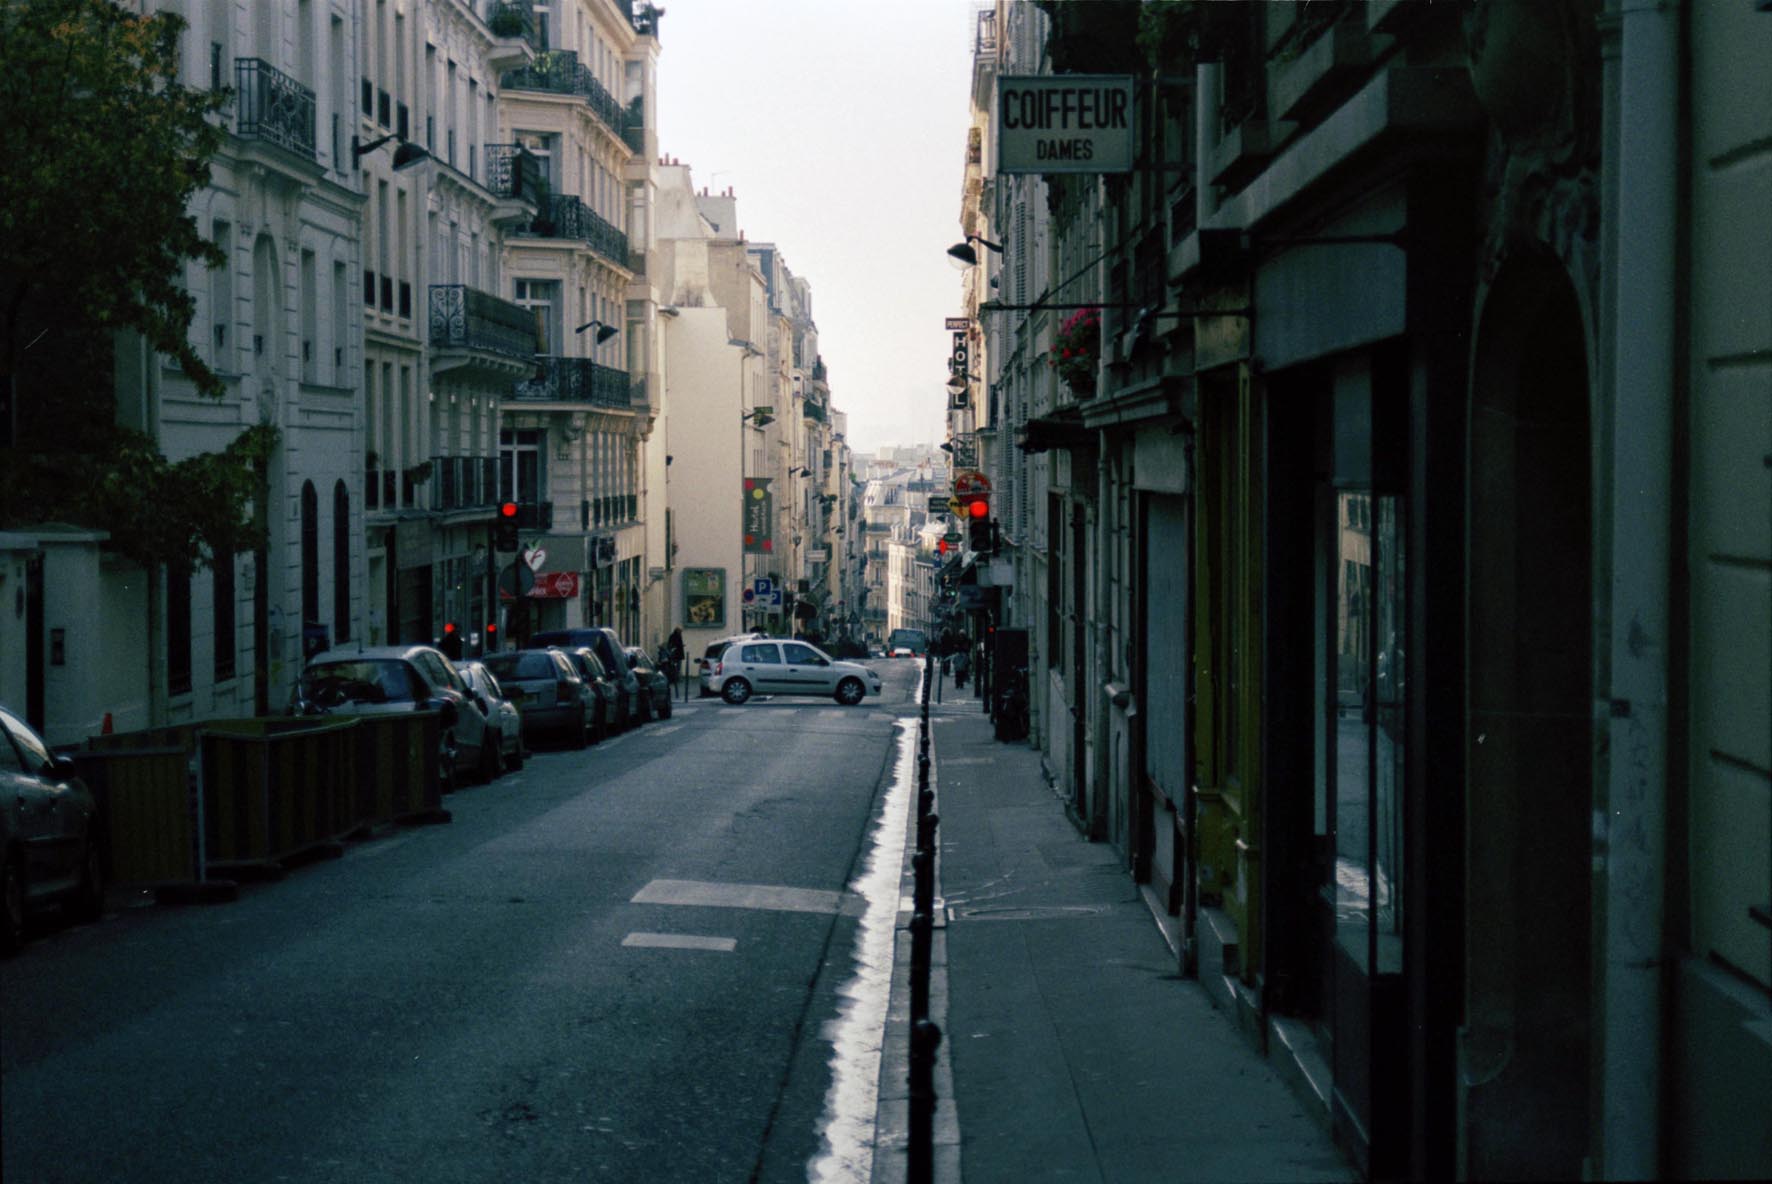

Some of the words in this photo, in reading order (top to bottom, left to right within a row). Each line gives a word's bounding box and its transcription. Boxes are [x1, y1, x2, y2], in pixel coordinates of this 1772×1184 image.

[1004, 88, 1127, 129] COIFFEUR
[1037, 138, 1093, 160] DAMES
[955, 337, 966, 405] HOTL
